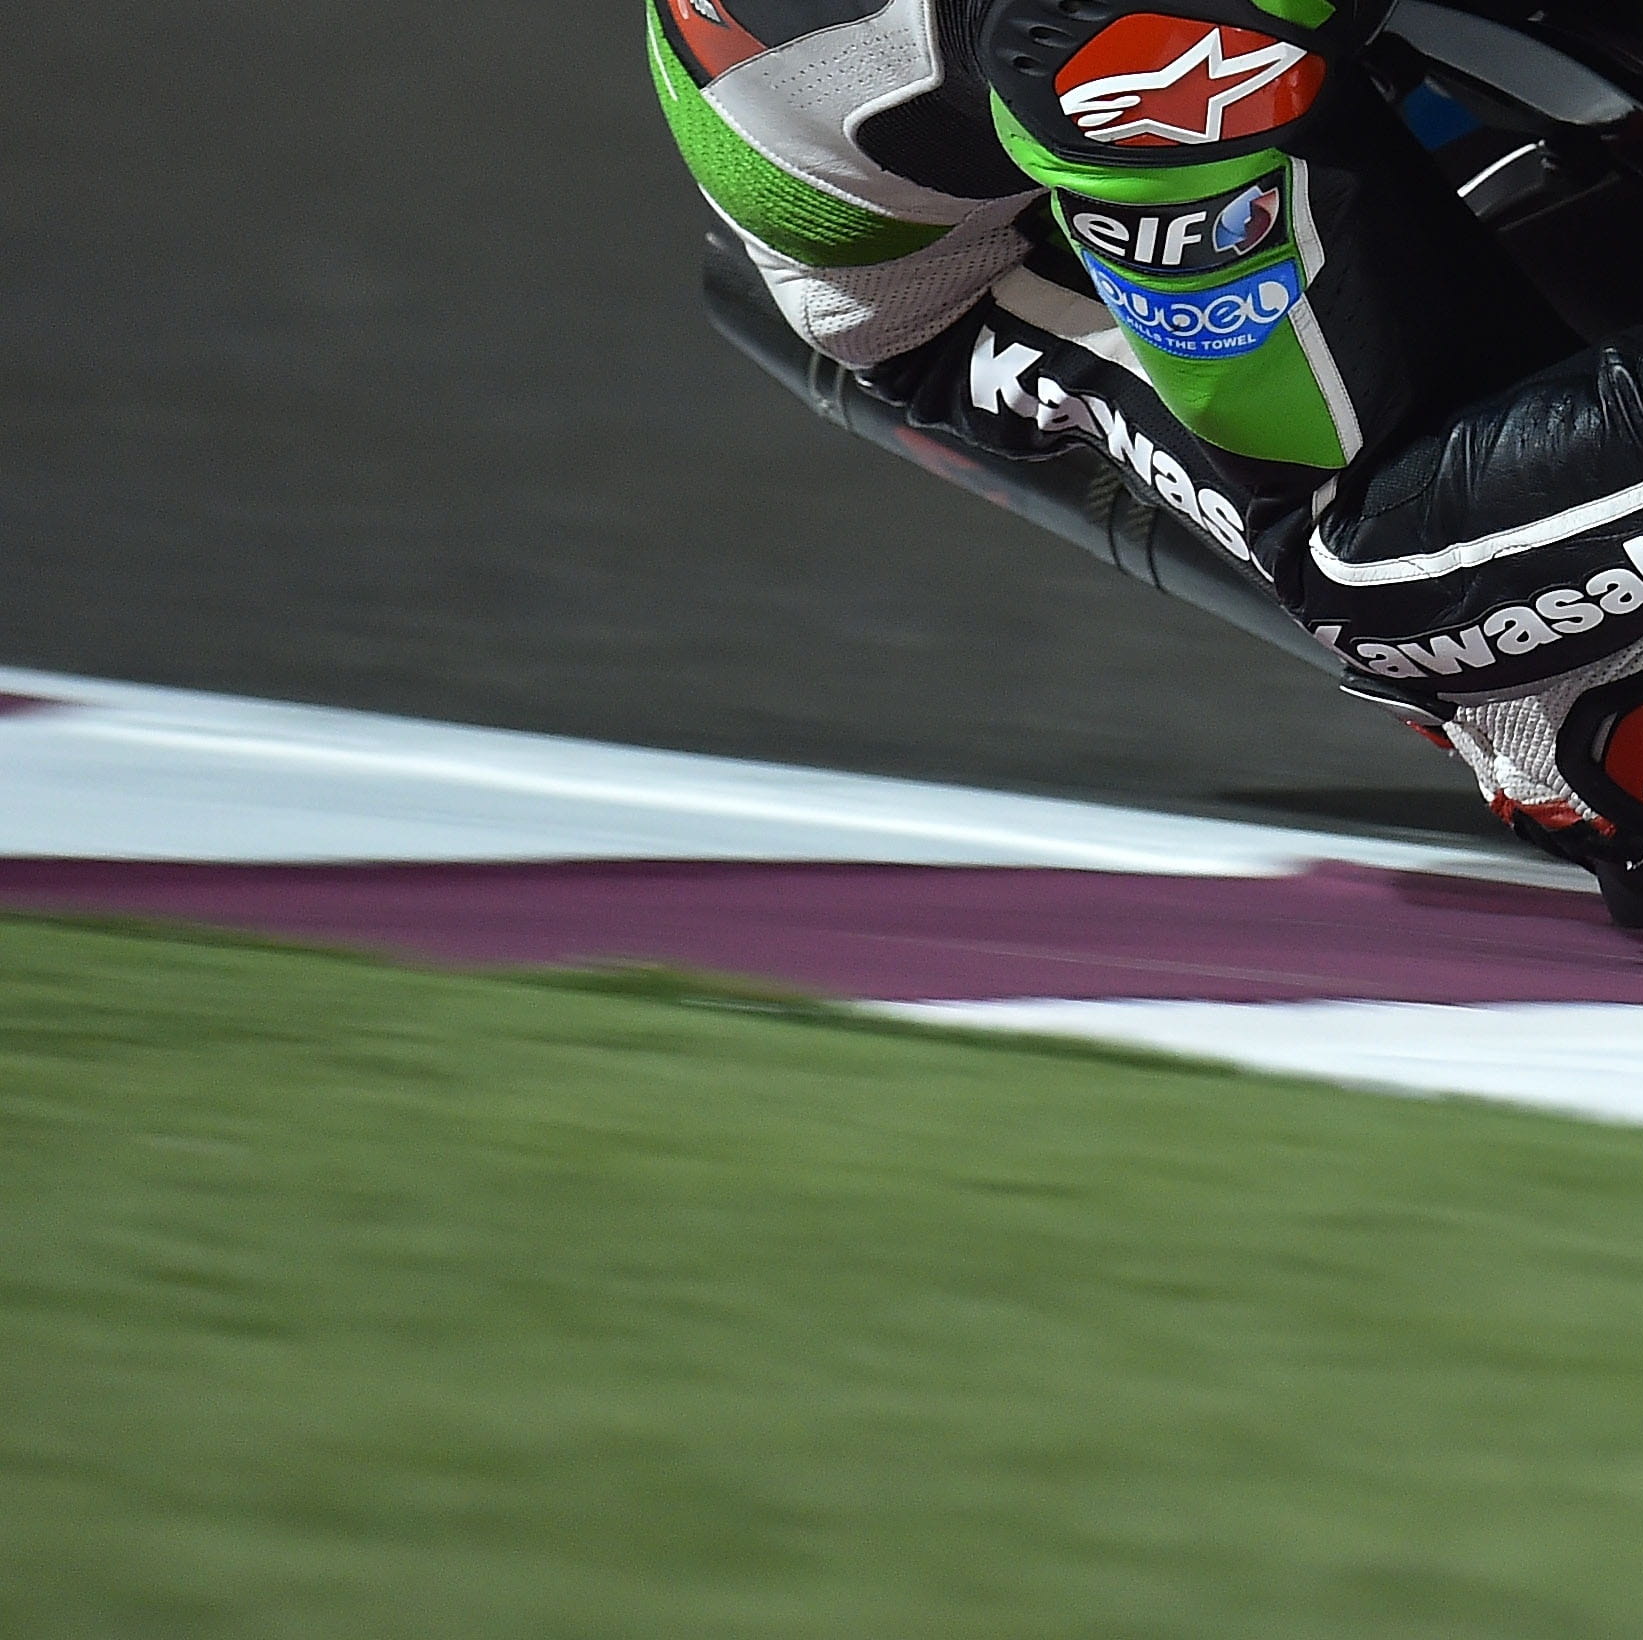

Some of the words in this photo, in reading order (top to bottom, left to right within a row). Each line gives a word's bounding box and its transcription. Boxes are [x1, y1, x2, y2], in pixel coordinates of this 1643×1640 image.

[1073, 211, 1206, 264] elf
[1126, 316, 1162, 343] KILLS
[1165, 337, 1196, 350] THE
[1201, 334, 1256, 350] TOWEL
[970, 325, 1274, 582] Kawas
